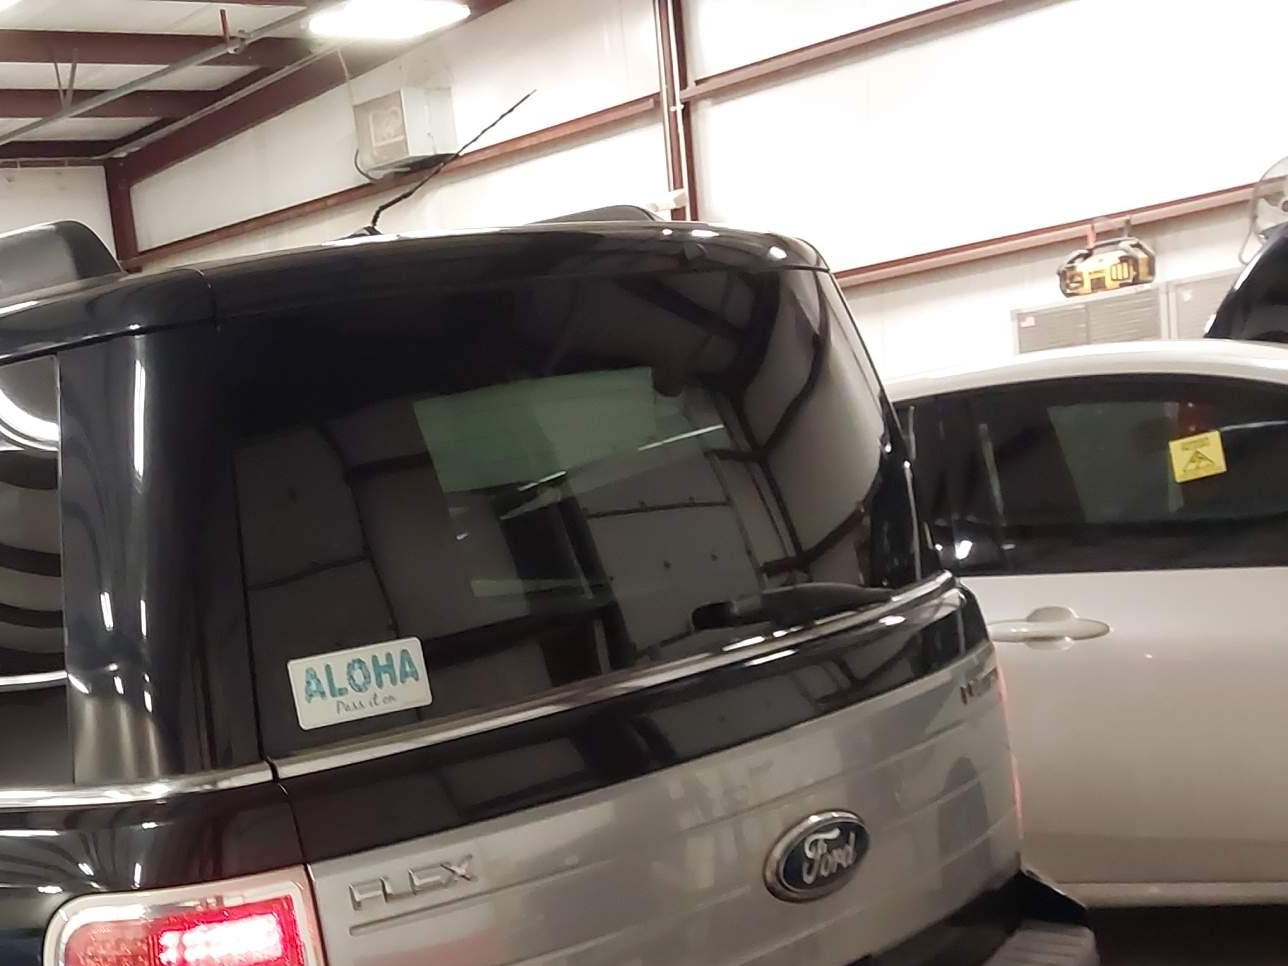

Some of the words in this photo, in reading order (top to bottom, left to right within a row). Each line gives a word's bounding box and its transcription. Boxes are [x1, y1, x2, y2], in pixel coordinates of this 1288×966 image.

[304, 649, 420, 703] ALOHA
[348, 854, 474, 911] FLEX
[802, 827, 857, 885] Ford
